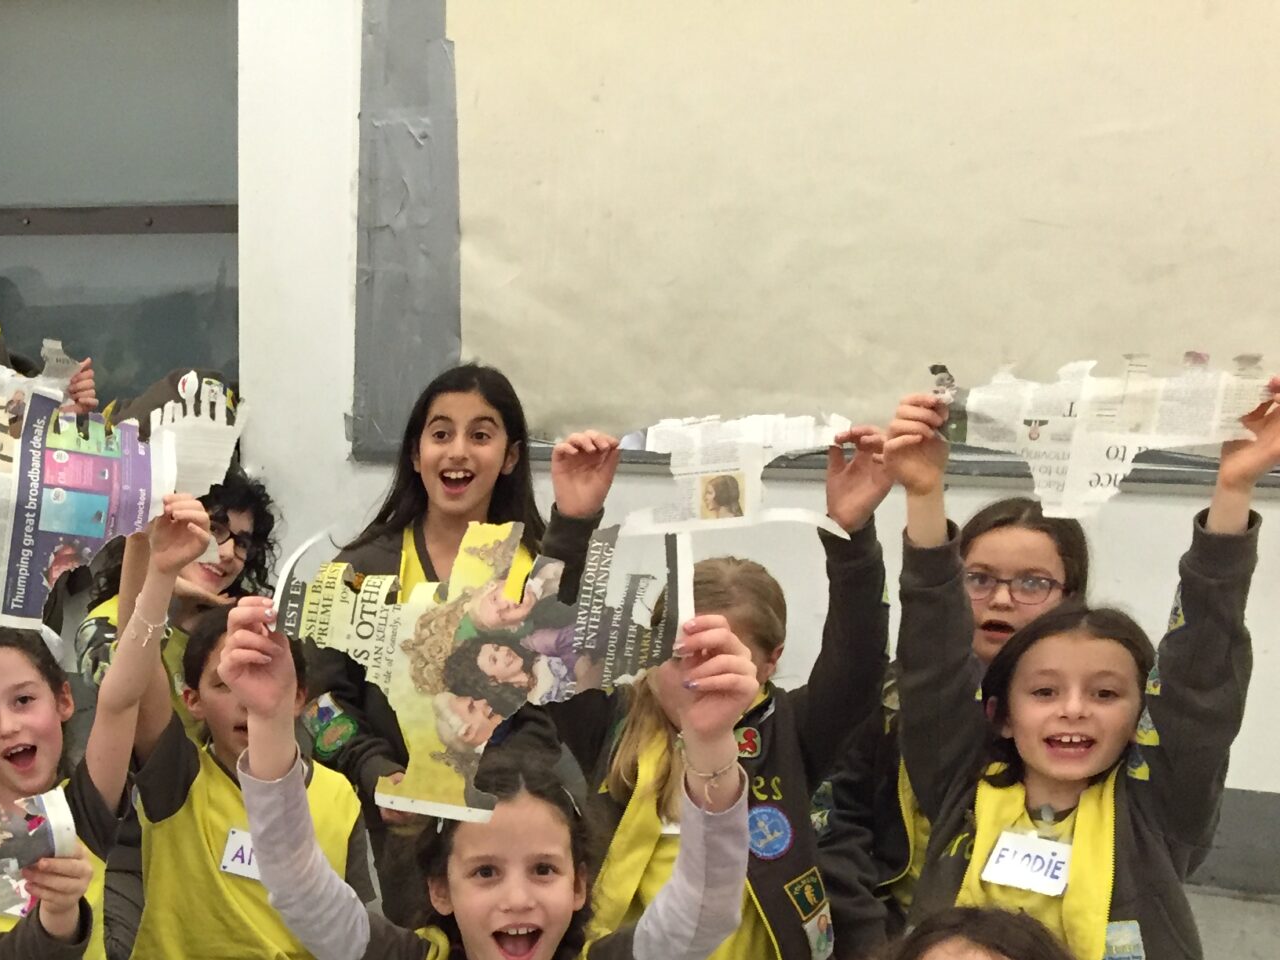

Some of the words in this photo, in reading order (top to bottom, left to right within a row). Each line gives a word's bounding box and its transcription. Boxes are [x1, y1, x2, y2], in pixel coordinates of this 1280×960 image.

[33, 415, 47, 449] deals.
[27, 450, 41, 510] broadband
[23, 512, 36, 548] great
[11, 550, 33, 609] Thumping
[377, 605, 389, 643] KELLY
[624, 624, 638, 657] PETER
